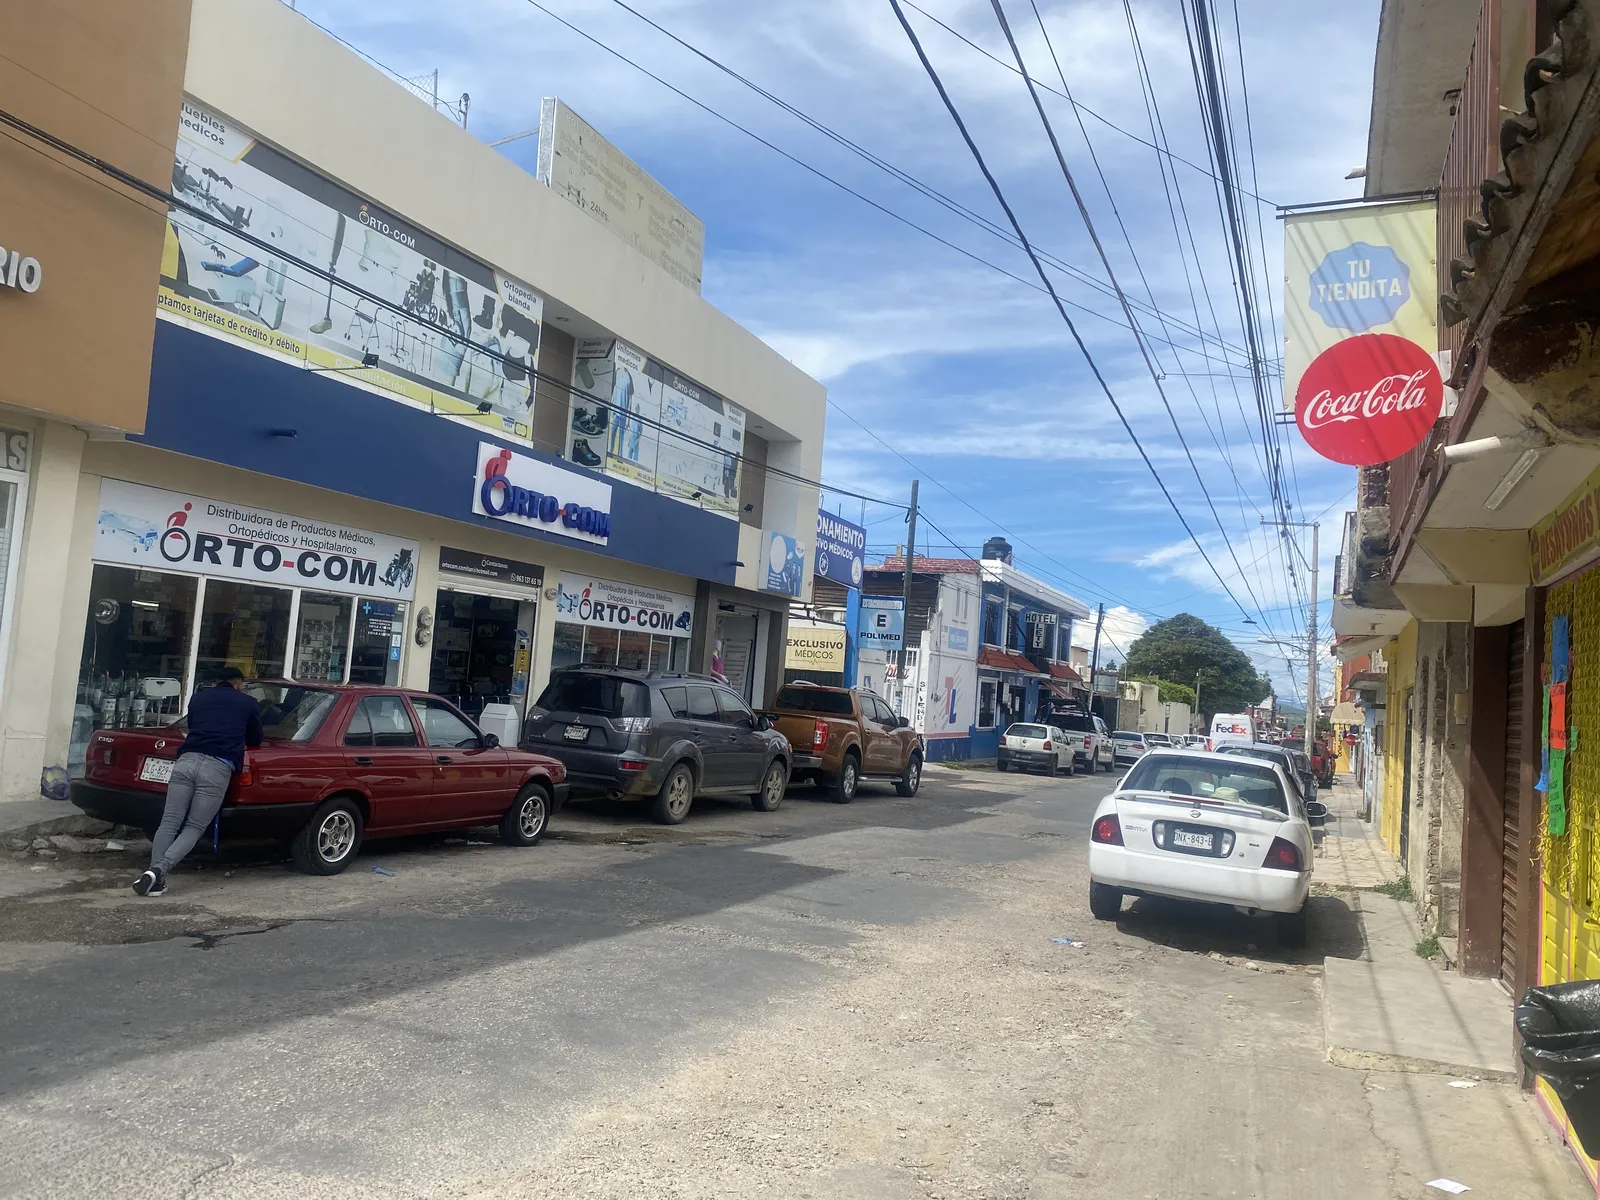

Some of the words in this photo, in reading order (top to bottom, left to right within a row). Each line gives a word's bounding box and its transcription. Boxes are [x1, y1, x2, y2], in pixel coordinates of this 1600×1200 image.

[180, 102, 225, 133] uebles
[359, 211, 416, 248] ORTO-COM
[1347, 259, 1371, 279] TU
[503, 280, 537, 304] Ortopedia
[508, 292, 531, 311] blanda
[1317, 277, 1402, 303] TIENDITA
[193, 304, 226, 326] tarjetas
[227, 318, 238, 330] de
[239, 323, 268, 342] crédito
[269, 335, 275, 345] y
[276, 336, 300, 354] débito
[1303, 367, 1432, 429] Coca-Cola
[481, 474, 611, 537] ORTO-COM
[207, 504, 273, 526] Distribuidora
[276, 518, 288, 529] de
[291, 520, 337, 538] Productos
[339, 529, 376, 547] Médicos,
[228, 523, 290, 543] Ortopédicos
[292, 536, 298, 546] y
[300, 536, 357, 555] Hospitalarios
[160, 526, 378, 587] ORTO-COM
[598, 582, 627, 595] Distribuidora
[634, 589, 656, 600] Productos
[607, 593, 634, 605] Ortopédicos
[579, 598, 675, 631] ORTO-COM
[877, 614, 887, 628] E
[1025, 613, 1055, 624] HOTEL
[787, 638, 844, 650] EXCLUSIVO
[860, 631, 901, 641] POLIMED
[1034, 624, 1043, 647] LETY
[794, 648, 834, 660] MÉDICOS
[1216, 723, 1247, 735] FedEx
